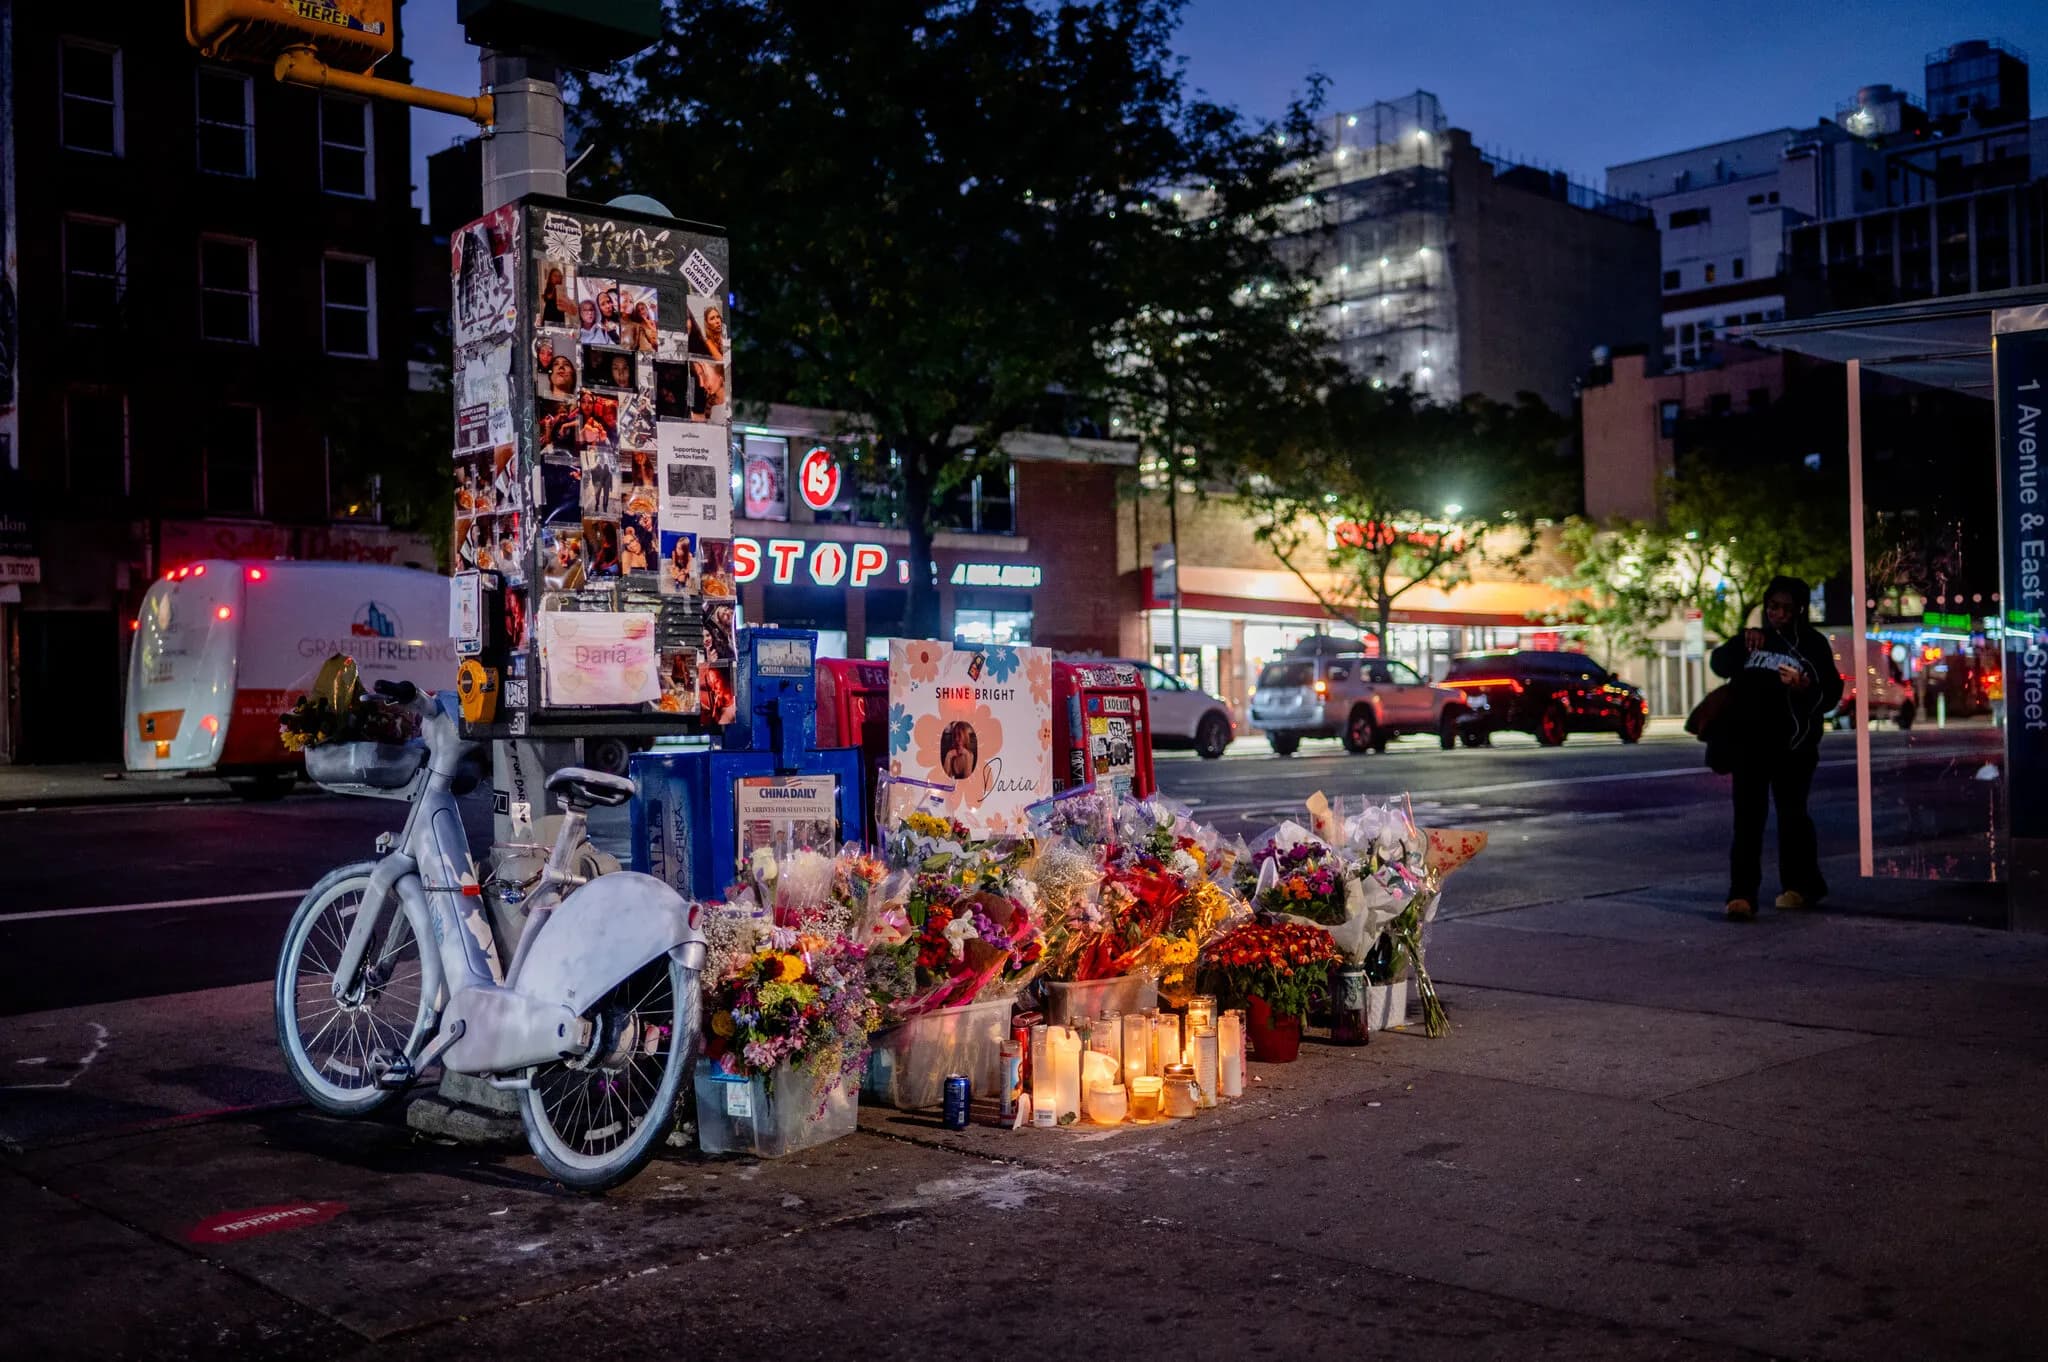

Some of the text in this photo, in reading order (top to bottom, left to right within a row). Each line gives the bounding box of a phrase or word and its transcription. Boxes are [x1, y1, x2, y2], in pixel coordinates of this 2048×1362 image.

[685, 267, 709, 294] GRIMES
[690, 260, 714, 288] TOPPED
[692, 251, 721, 285] MAXELLE
[2016, 377, 2041, 392] 1
[2016, 402, 2043, 505] Avenue
[2019, 510, 2046, 533] &
[734, 537, 888, 587] STOP
[2020, 539, 2047, 600] East
[575, 643, 627, 664] Daria
[935, 687, 1016, 701] SHINE BRIGHT
[2022, 649, 2048, 732] Street
[759, 787, 817, 799] CHINA DAILY
[977, 757, 1038, 803] Daria
